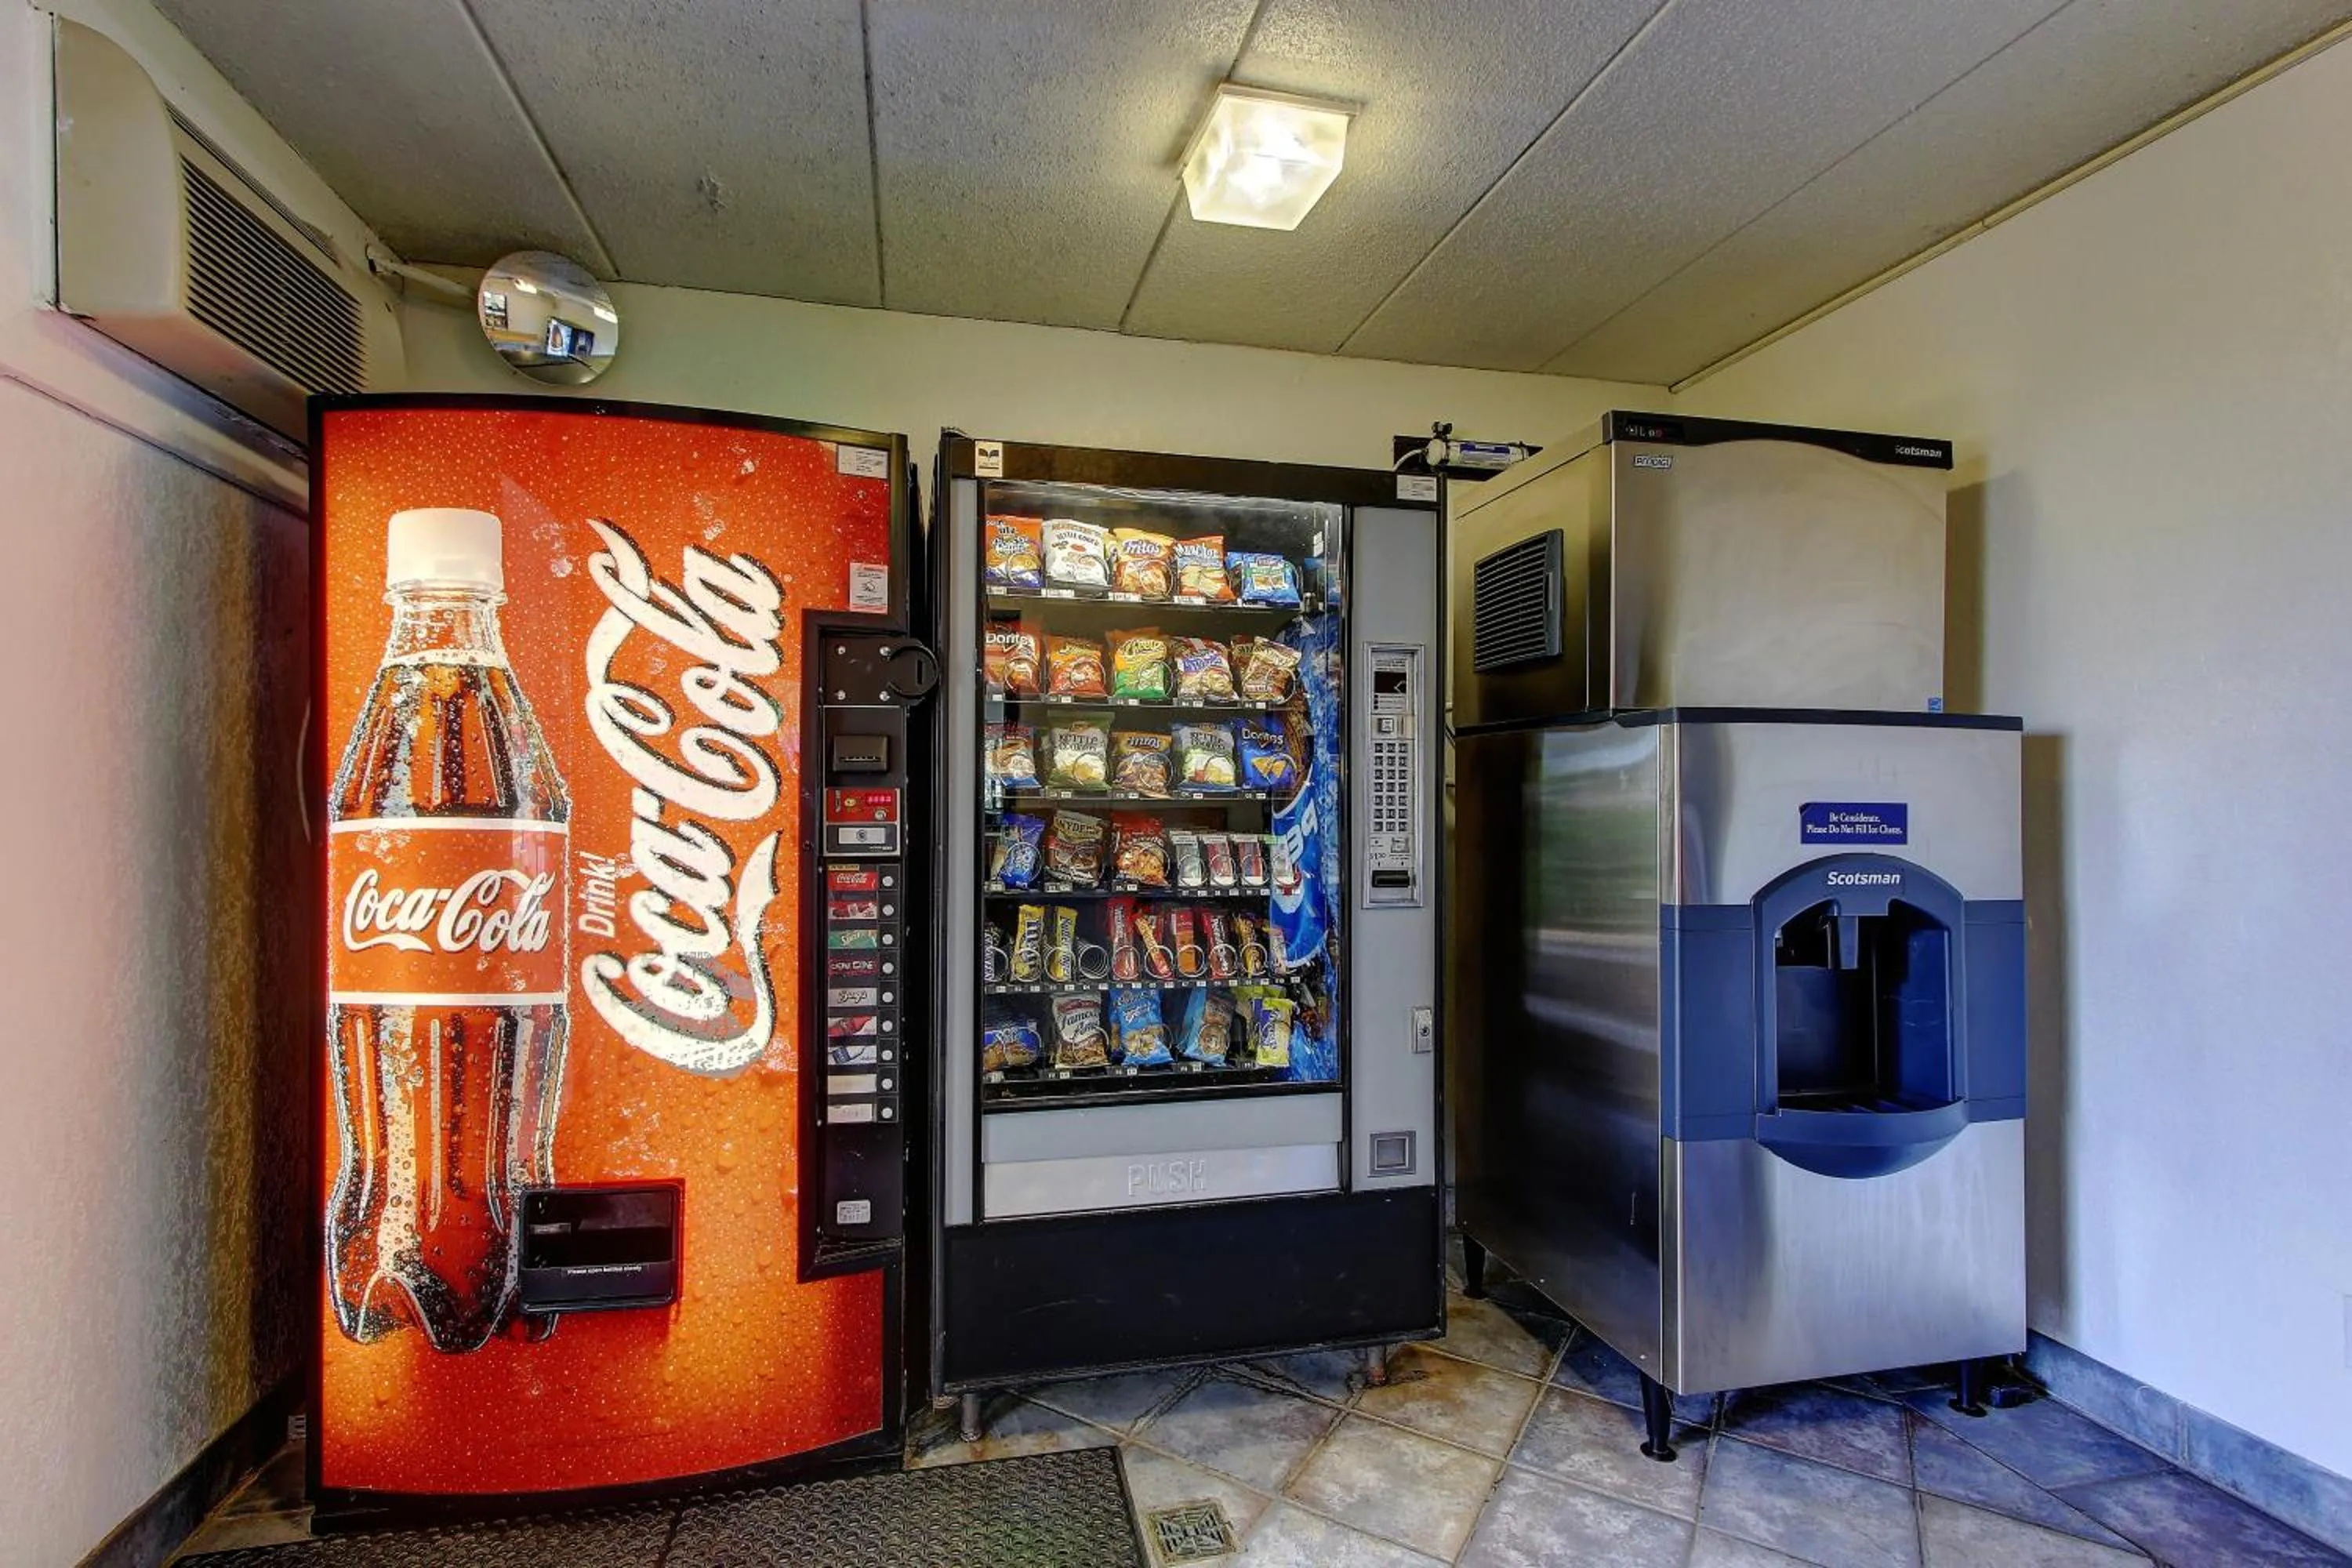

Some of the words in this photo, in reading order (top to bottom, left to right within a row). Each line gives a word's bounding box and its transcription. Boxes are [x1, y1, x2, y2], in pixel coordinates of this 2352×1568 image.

[1894, 445, 1944, 459] Scotsman
[985, 633, 1035, 646] Doritos
[1242, 728, 1284, 745] Doritos
[579, 517, 786, 1076] Coca-Cola
[1828, 824, 1839, 833] Do
[1840, 824, 1854, 833] Not
[1827, 871, 1901, 885] Scotsman
[578, 851, 616, 938] Drink!
[343, 868, 556, 954] Coca-Cola
[1128, 1160, 1207, 1196] PUSH
